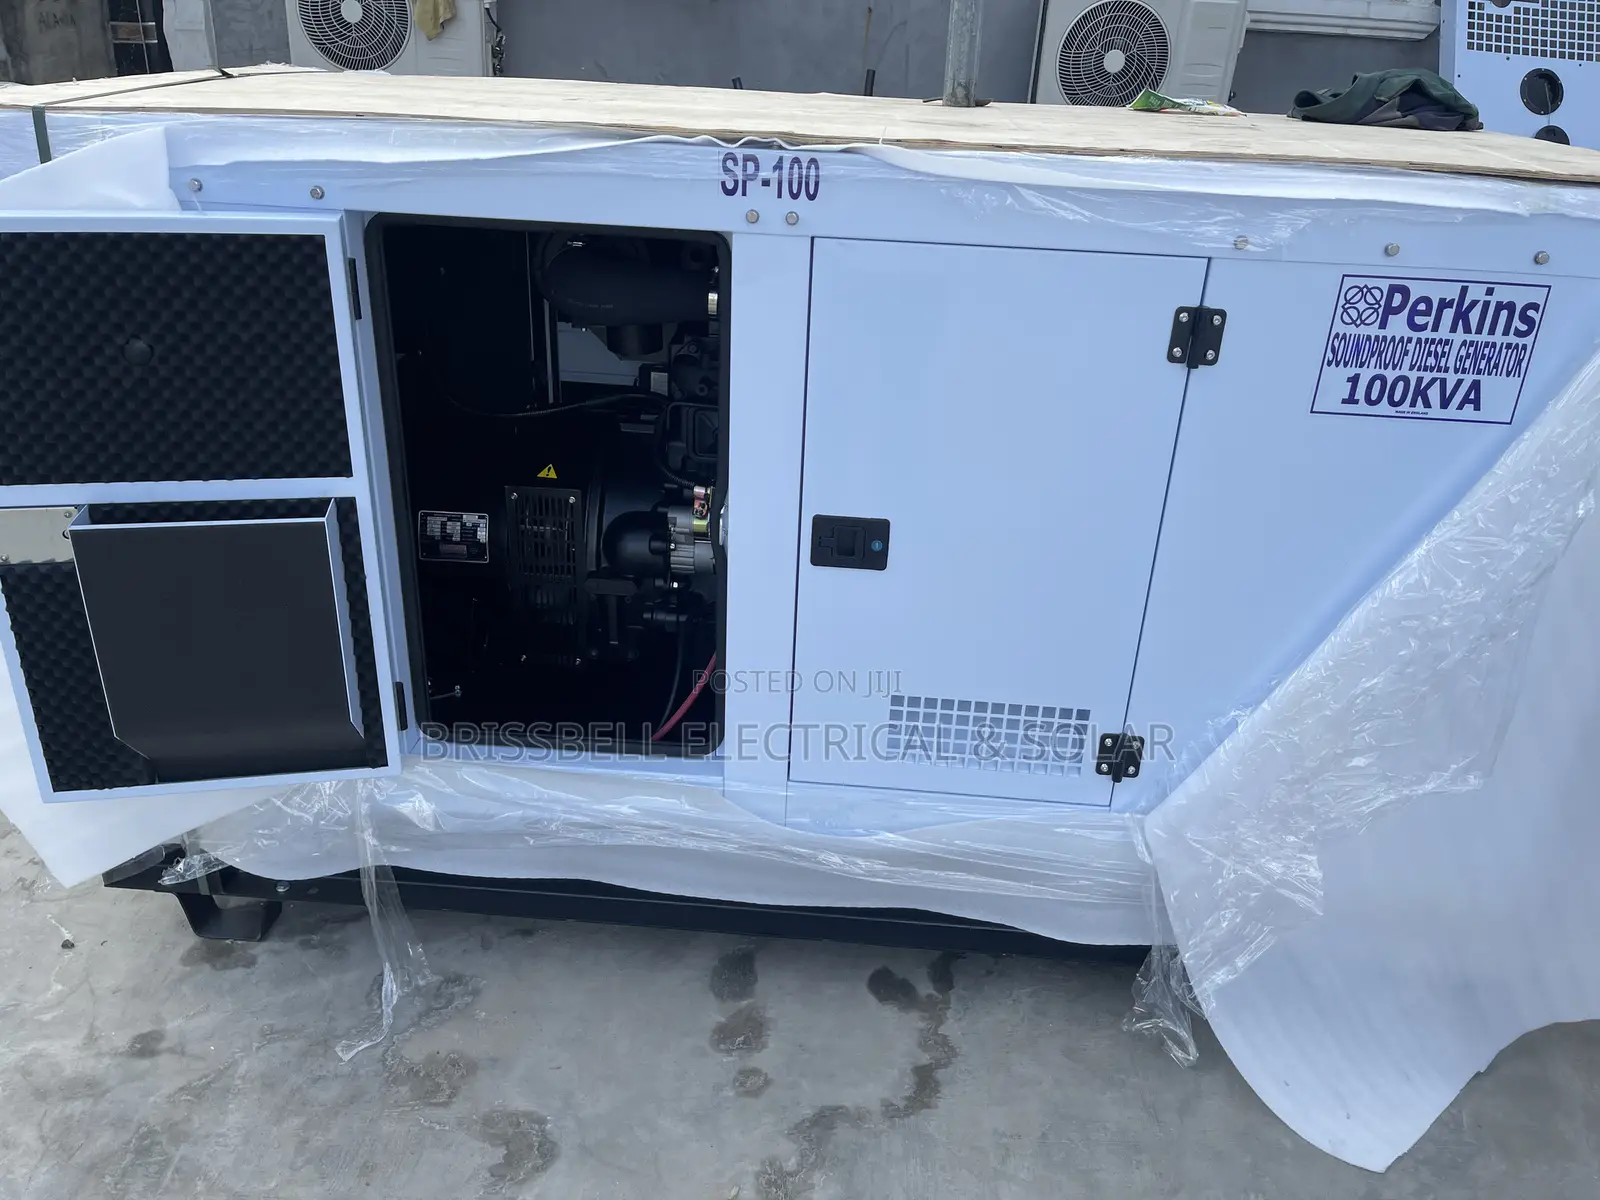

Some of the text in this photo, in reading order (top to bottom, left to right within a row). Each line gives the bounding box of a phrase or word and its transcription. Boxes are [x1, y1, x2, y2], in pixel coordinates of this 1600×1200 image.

[720, 152, 820, 201] SP-100
[1377, 283, 1541, 338] Perkins
[1326, 331, 1528, 378] SOUNDPROOF DIESEL GENERATOR
[1340, 372, 1482, 412] 100KVA
